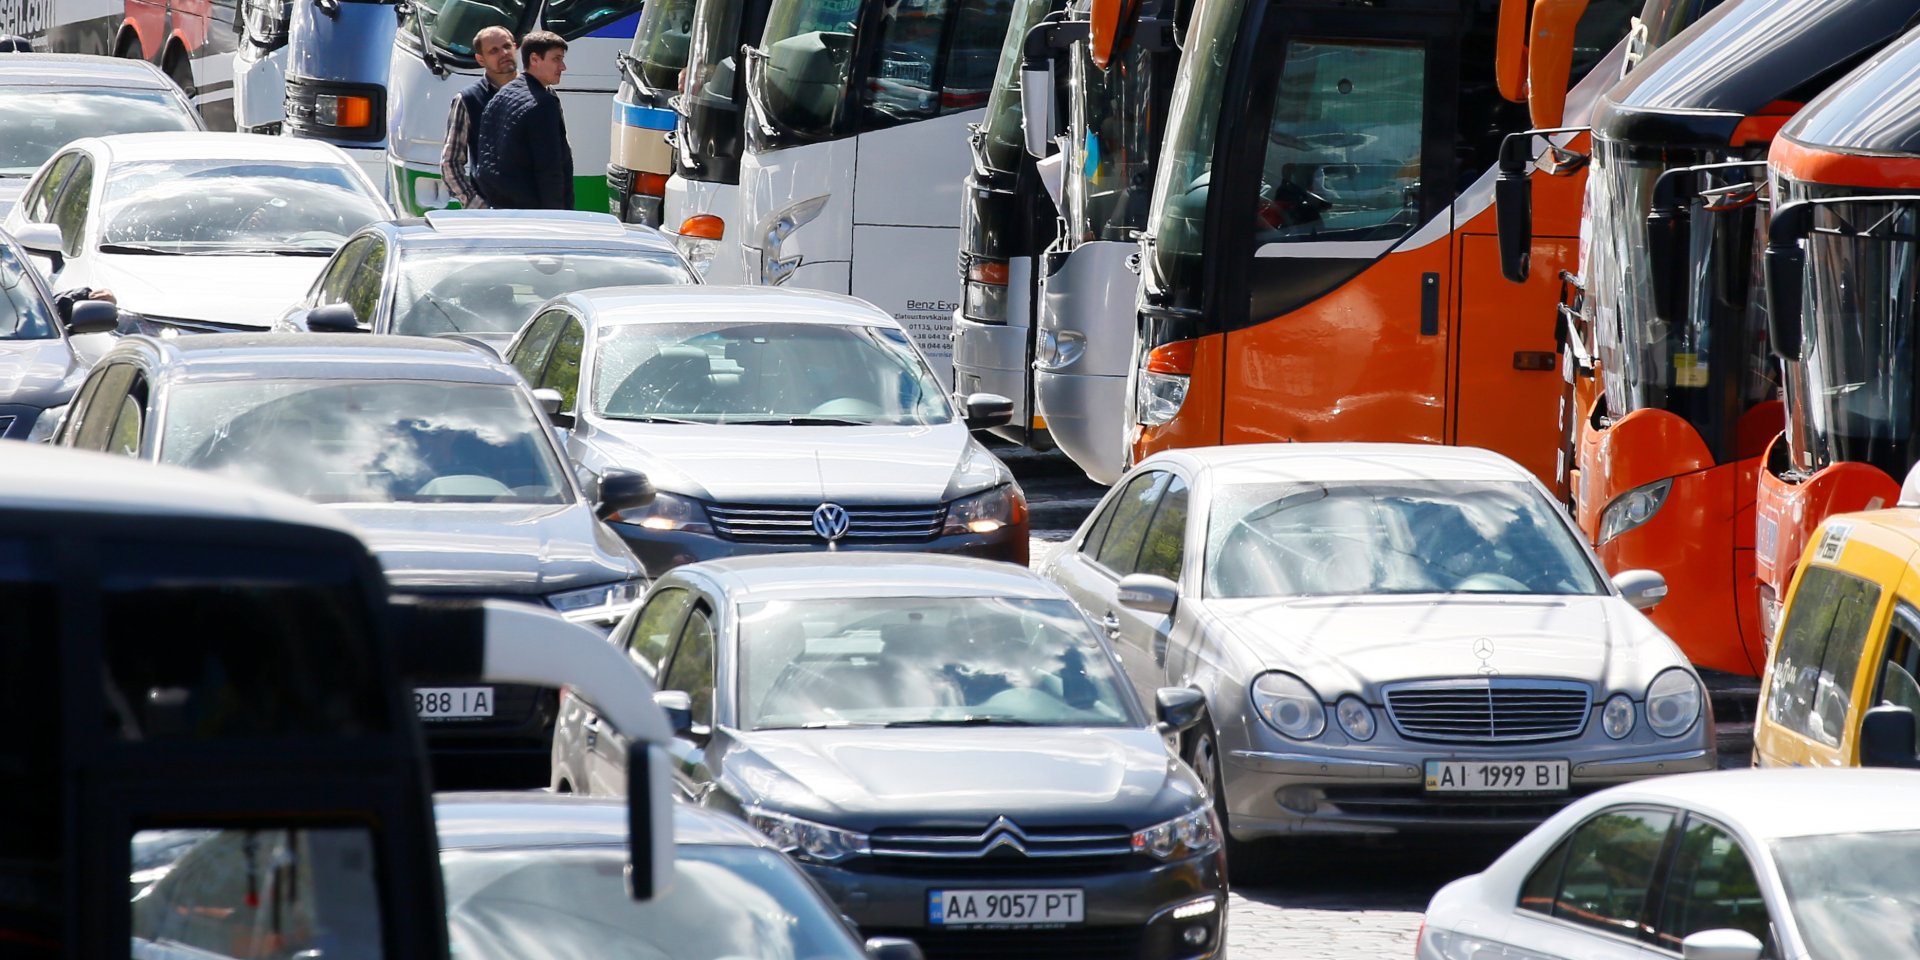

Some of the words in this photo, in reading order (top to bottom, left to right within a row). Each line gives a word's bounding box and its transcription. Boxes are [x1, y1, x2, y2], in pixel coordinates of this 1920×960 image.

[907, 300, 935, 309] Benz
[938, 300, 960, 311] Exp
[462, 692, 489, 713] IA
[1440, 765, 1466, 787] AI
[1478, 765, 1526, 787] 1999
[1536, 765, 1561, 786] BI
[946, 895, 978, 918] AA
[986, 894, 1038, 918] 9057
[1045, 893, 1077, 917] PT
